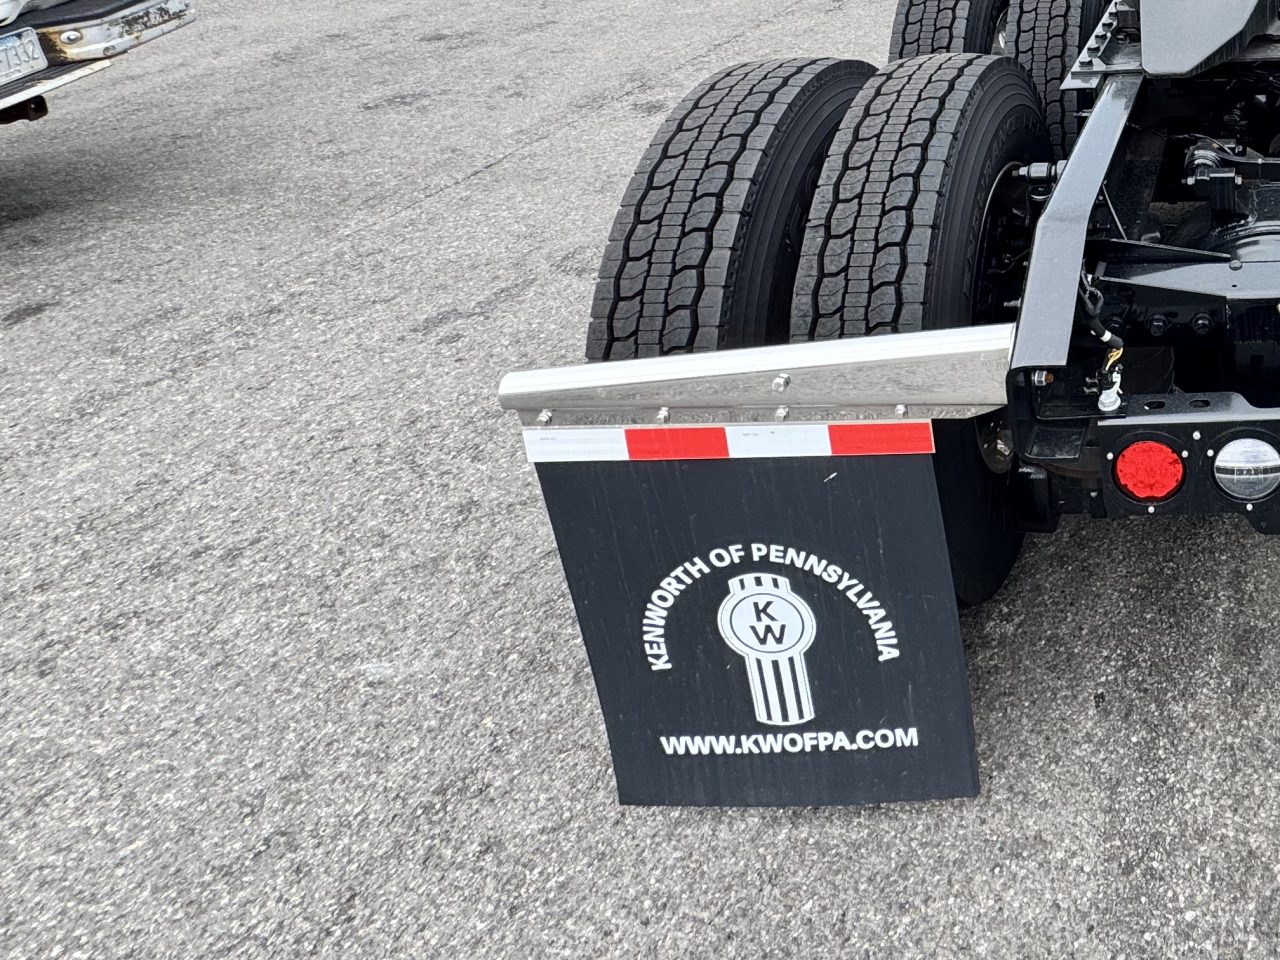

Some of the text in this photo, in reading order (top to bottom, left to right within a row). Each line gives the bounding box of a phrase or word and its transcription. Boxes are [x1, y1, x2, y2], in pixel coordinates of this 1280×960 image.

[642, 542, 900, 671] KENWORTH OF PENNSYLVANIA
[659, 727, 919, 756] WWW.KWOFPA.COM
